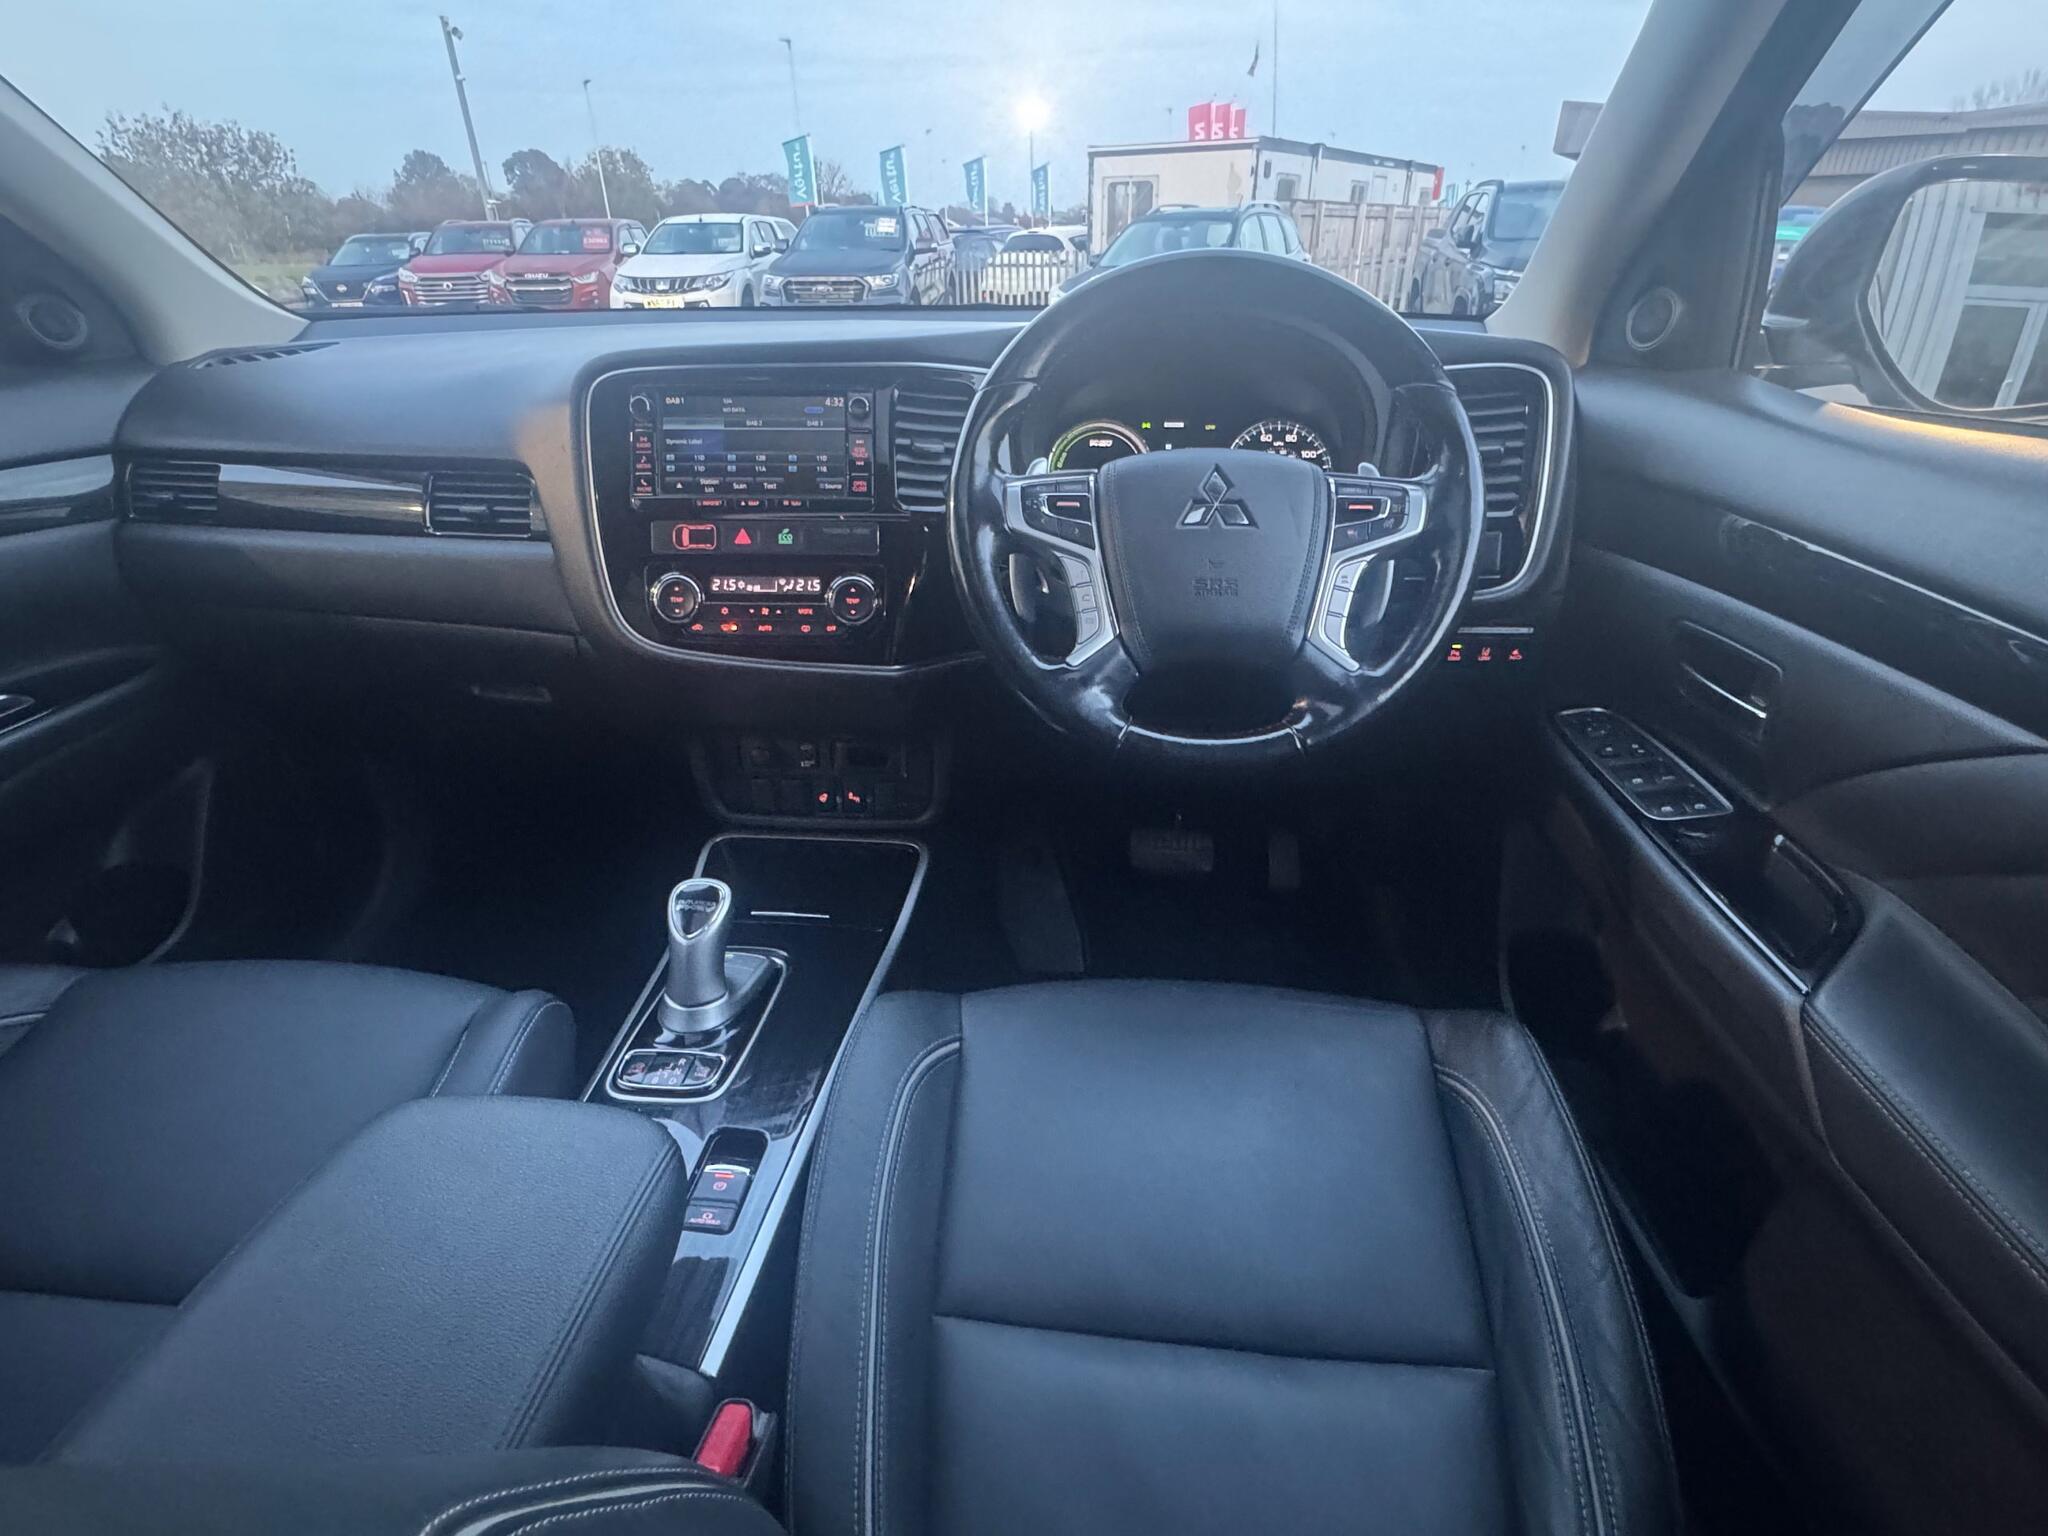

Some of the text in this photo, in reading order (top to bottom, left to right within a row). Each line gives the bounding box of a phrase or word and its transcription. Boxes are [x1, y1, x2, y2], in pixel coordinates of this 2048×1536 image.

[665, 397, 680, 405] DAB
[825, 397, 844, 407] 4:32
[1260, 434, 1272, 442] 60
[1285, 434, 1297, 442] 80
[1301, 450, 1317, 459] 100
[763, 482, 777, 490] Text
[1192, 578, 1238, 590] SRS
